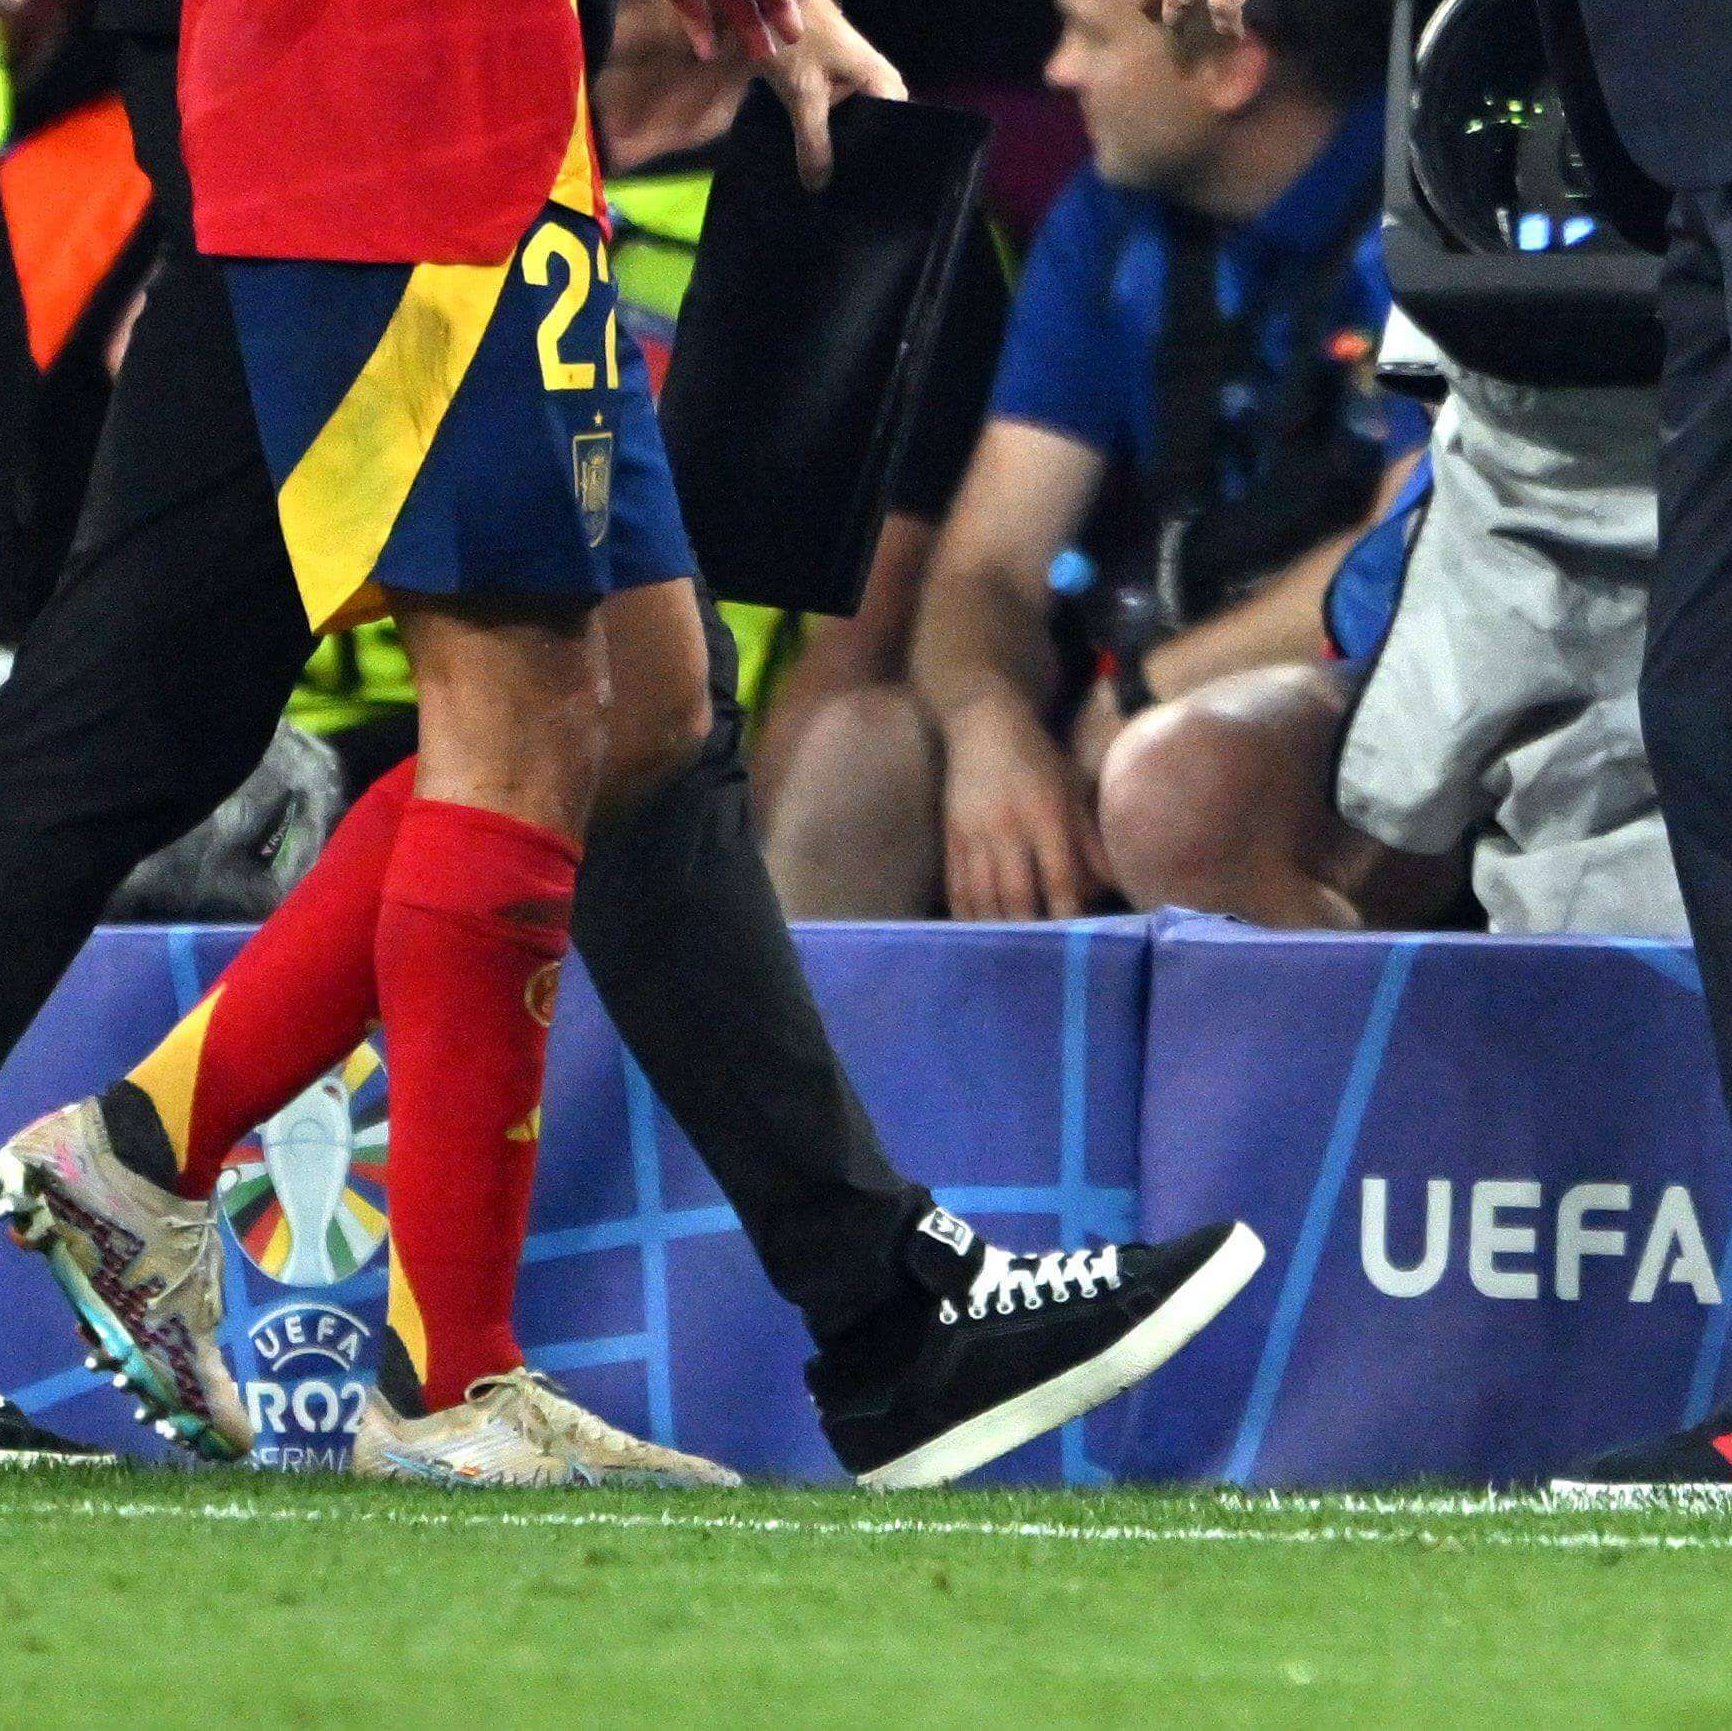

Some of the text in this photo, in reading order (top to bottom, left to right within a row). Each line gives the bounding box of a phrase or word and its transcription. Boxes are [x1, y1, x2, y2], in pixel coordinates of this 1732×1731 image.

[521, 221, 619, 391] 2
[254, 1315, 361, 1361] UEFA
[245, 1380, 367, 1434] RO2
